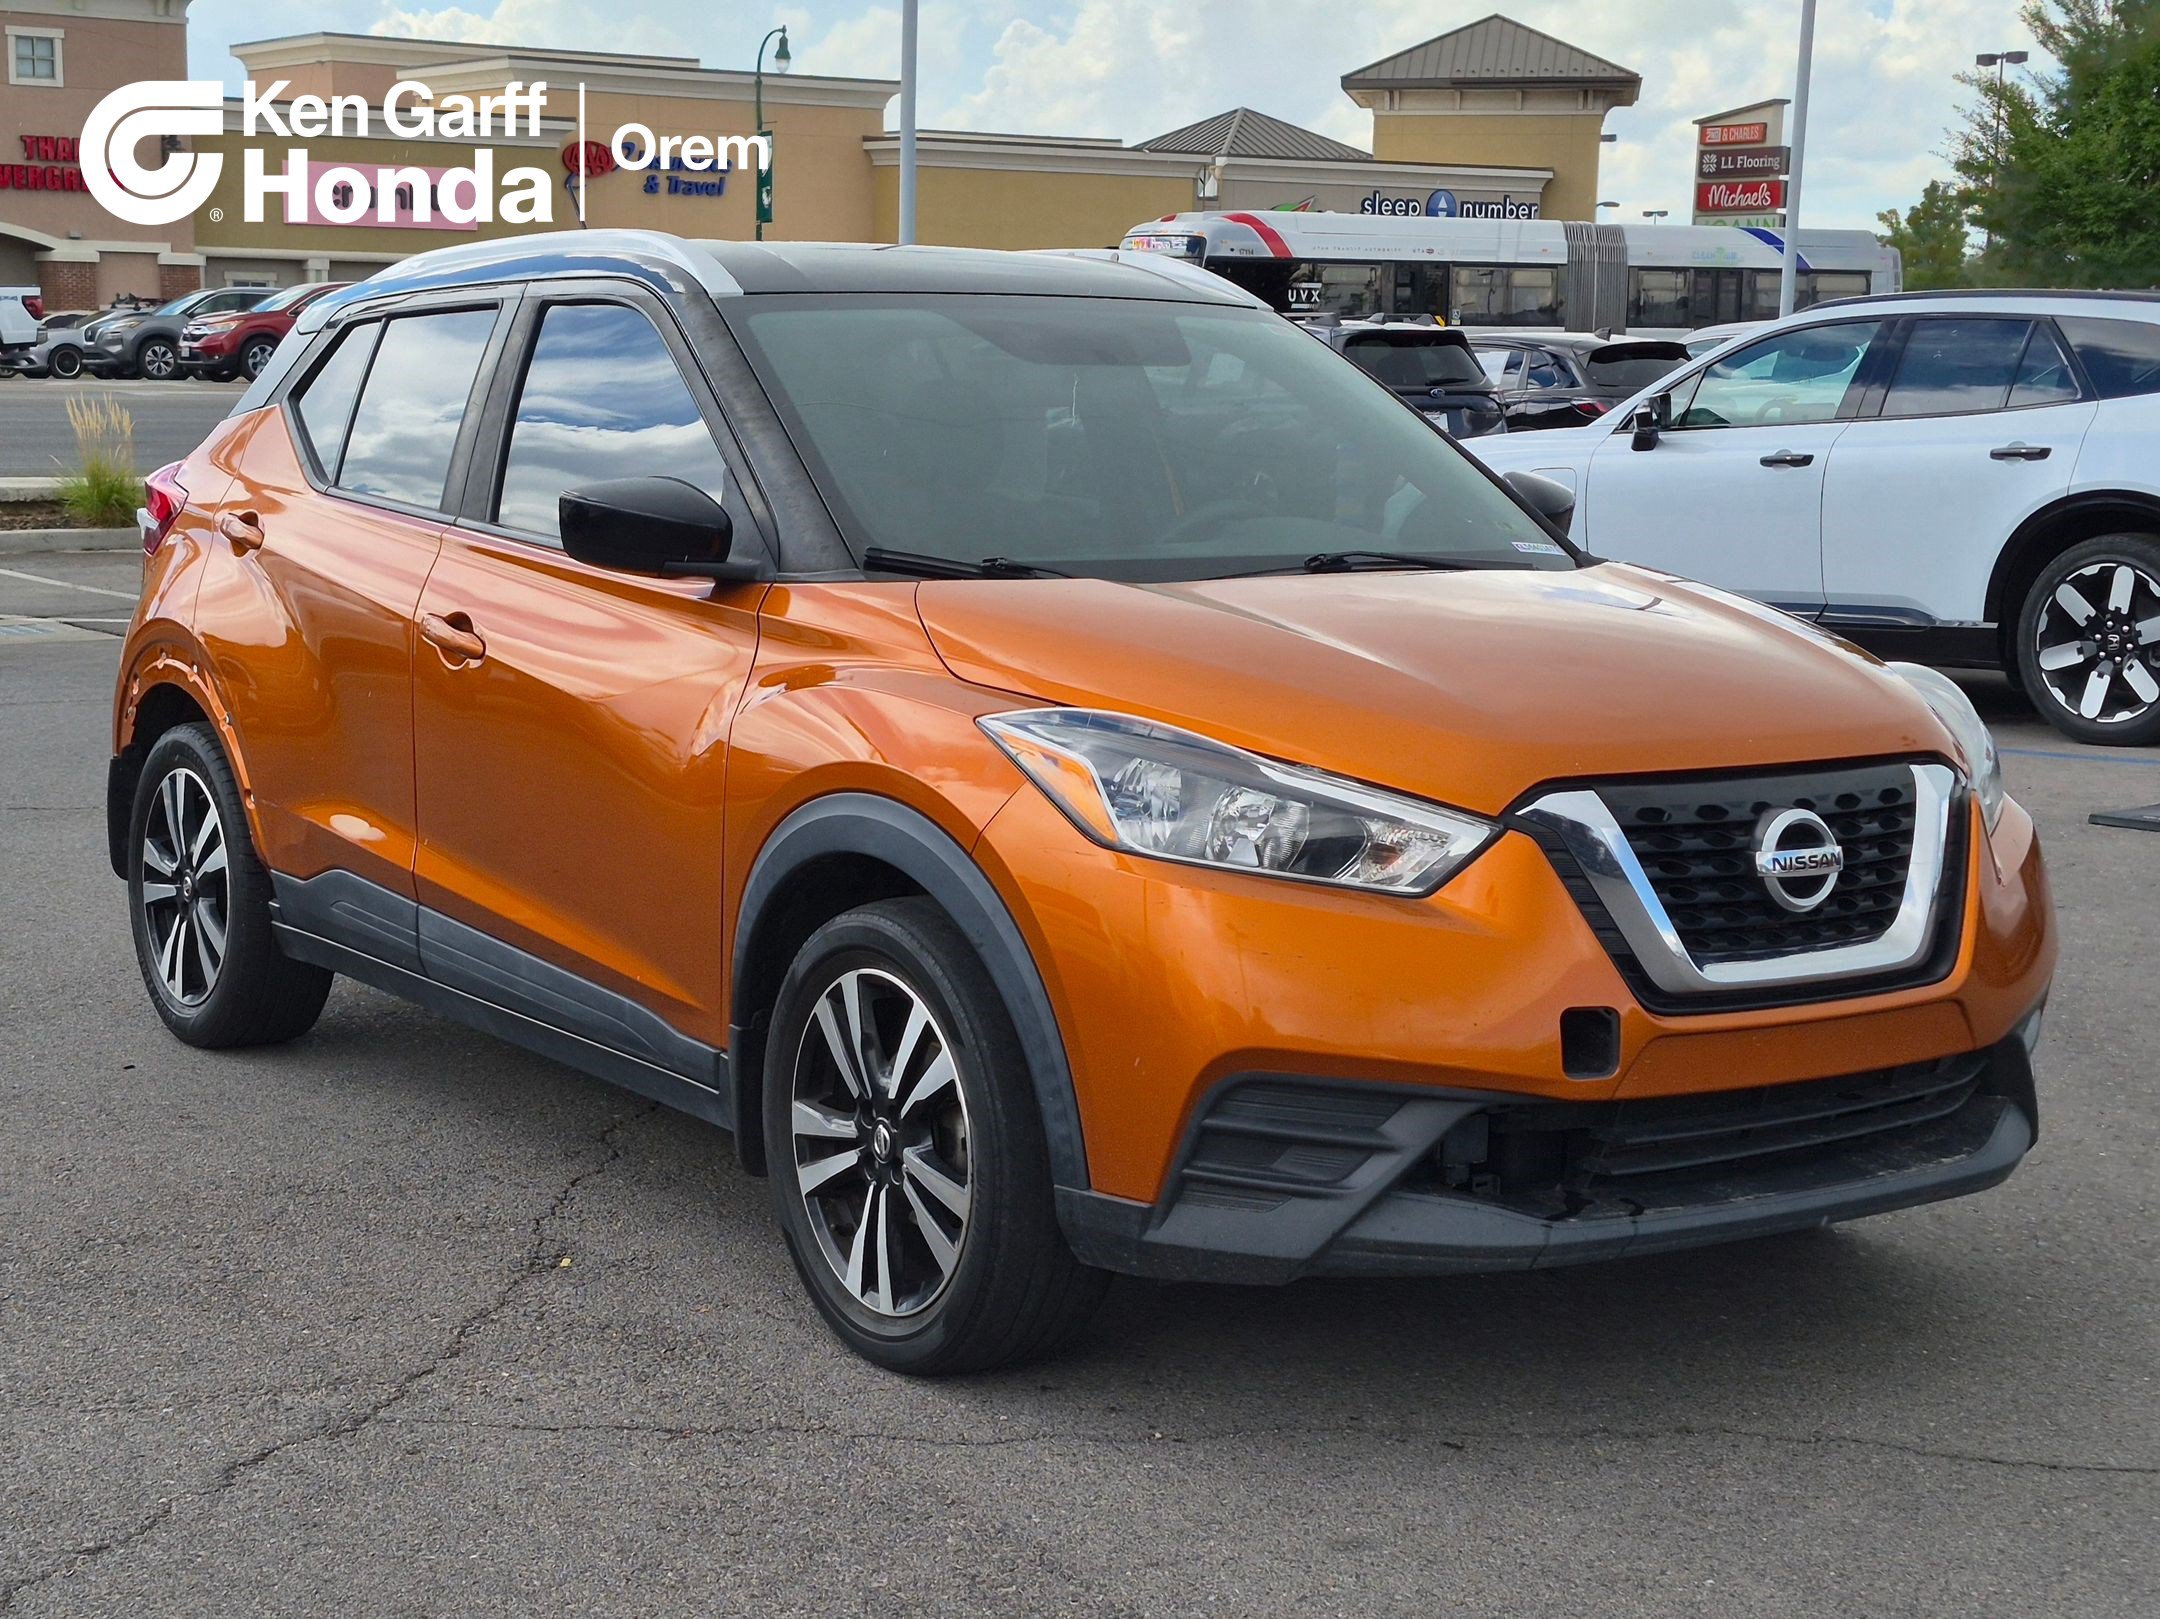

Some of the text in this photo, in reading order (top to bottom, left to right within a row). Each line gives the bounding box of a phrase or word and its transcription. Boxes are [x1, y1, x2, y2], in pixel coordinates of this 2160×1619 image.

[1729, 125, 1759, 141] CHARLES
[1721, 155, 1780, 171] LL Flooring
[643, 174, 726, 197] & Travel
[1708, 182, 1772, 207] Michaels
[1362, 192, 1538, 220] sleep number
[1288, 289, 1320, 302] UVX
[1771, 851, 1841, 872] NISSAN
